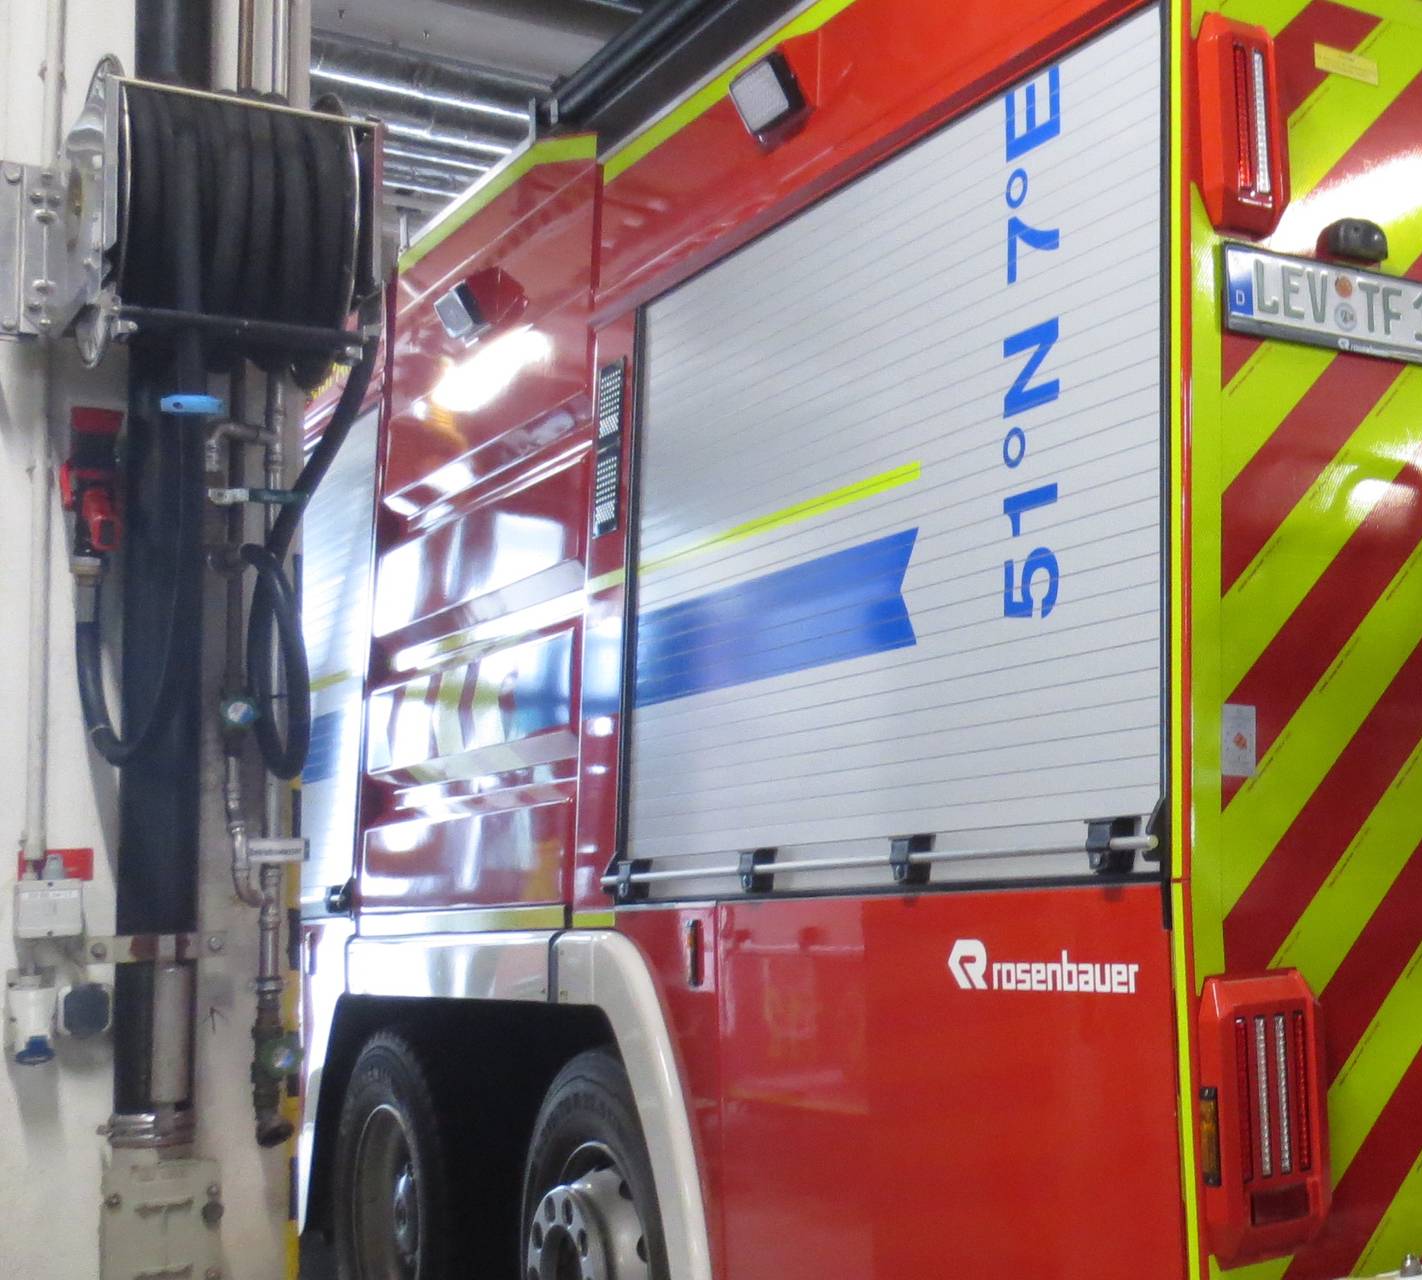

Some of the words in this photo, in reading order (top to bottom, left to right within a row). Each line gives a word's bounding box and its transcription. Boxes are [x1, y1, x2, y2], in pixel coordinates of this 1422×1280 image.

[1235, 289, 1246, 306] D
[1254, 259, 1328, 323] LEV
[1358, 280, 1403, 335] TF
[992, 949, 1140, 994] rosenbauer
